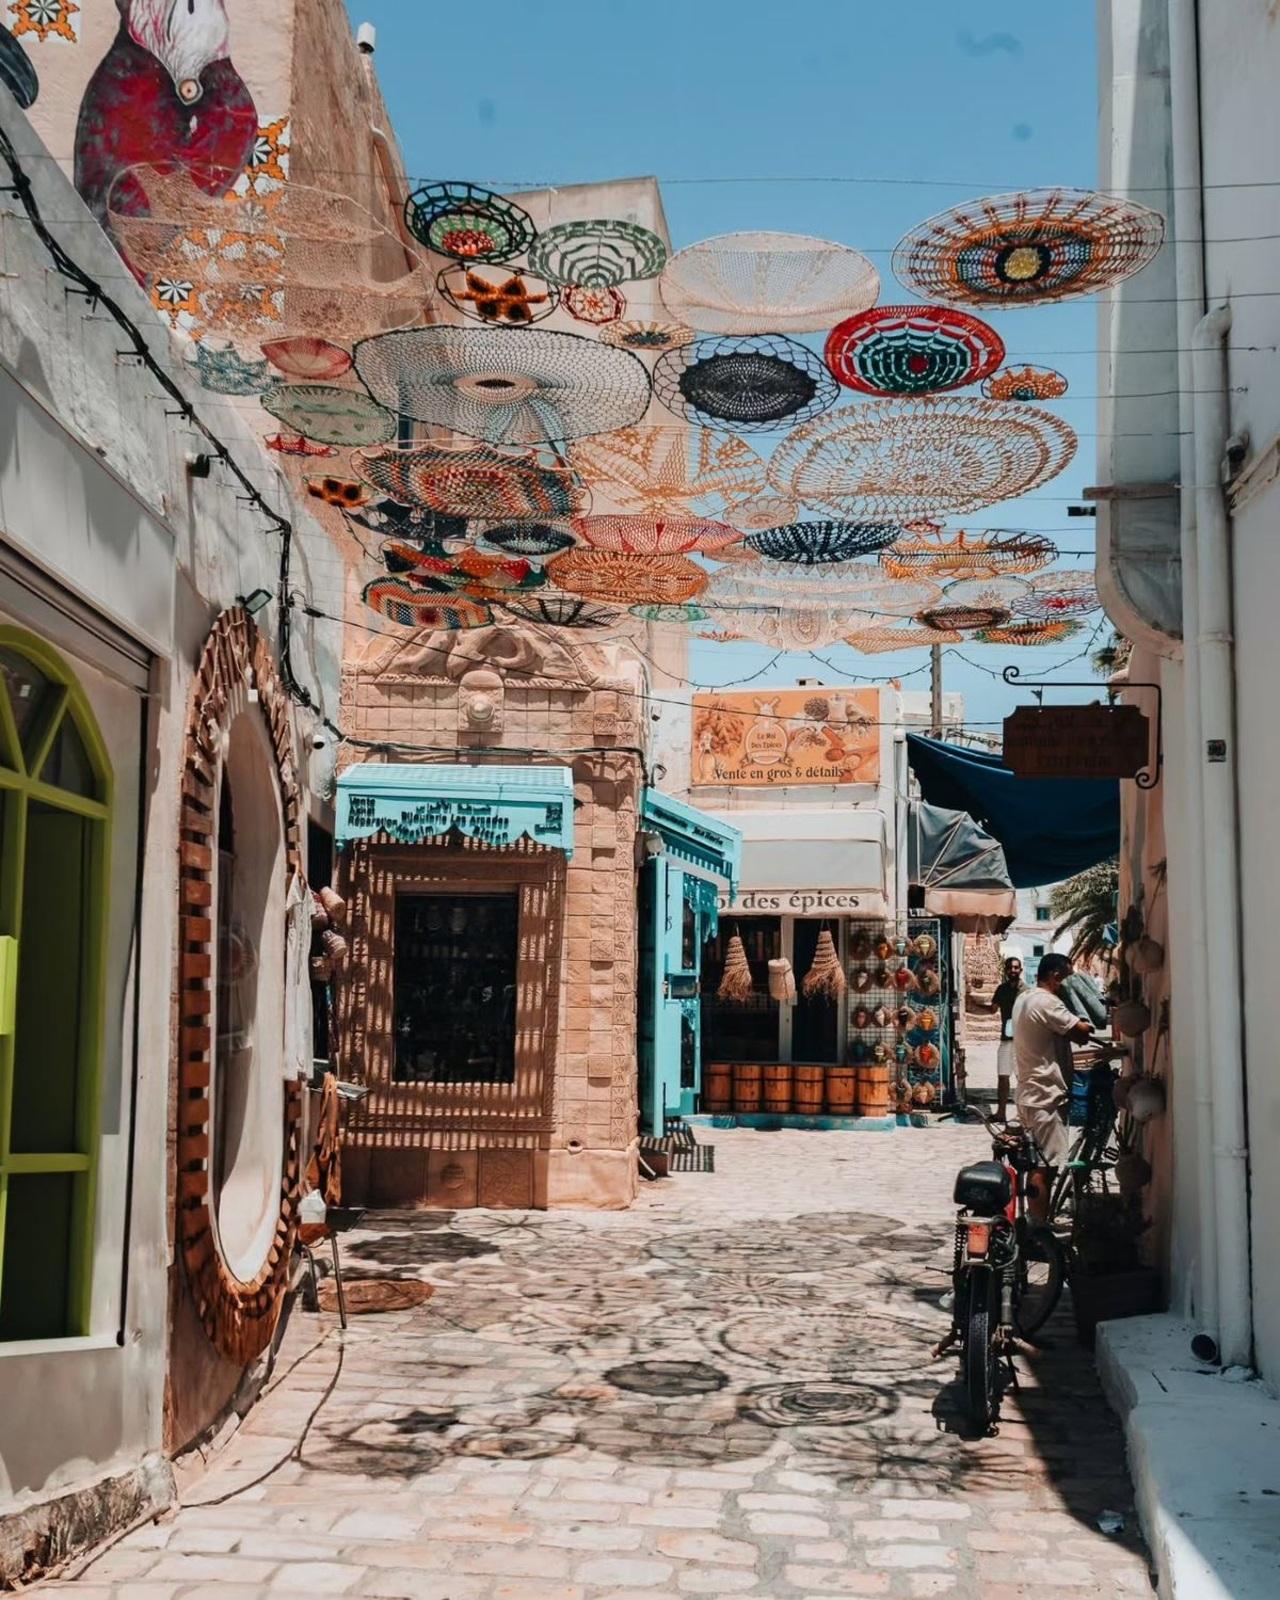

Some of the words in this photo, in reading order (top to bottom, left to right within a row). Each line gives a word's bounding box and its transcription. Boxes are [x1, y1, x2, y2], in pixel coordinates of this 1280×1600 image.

[715, 768, 749, 780] Vente
[750, 769, 764, 779] en
[767, 768, 792, 783] gros
[795, 766, 802, 778] &
[806, 765, 844, 778] détails
[742, 892, 780, 909] des
[789, 890, 860, 912] épices
